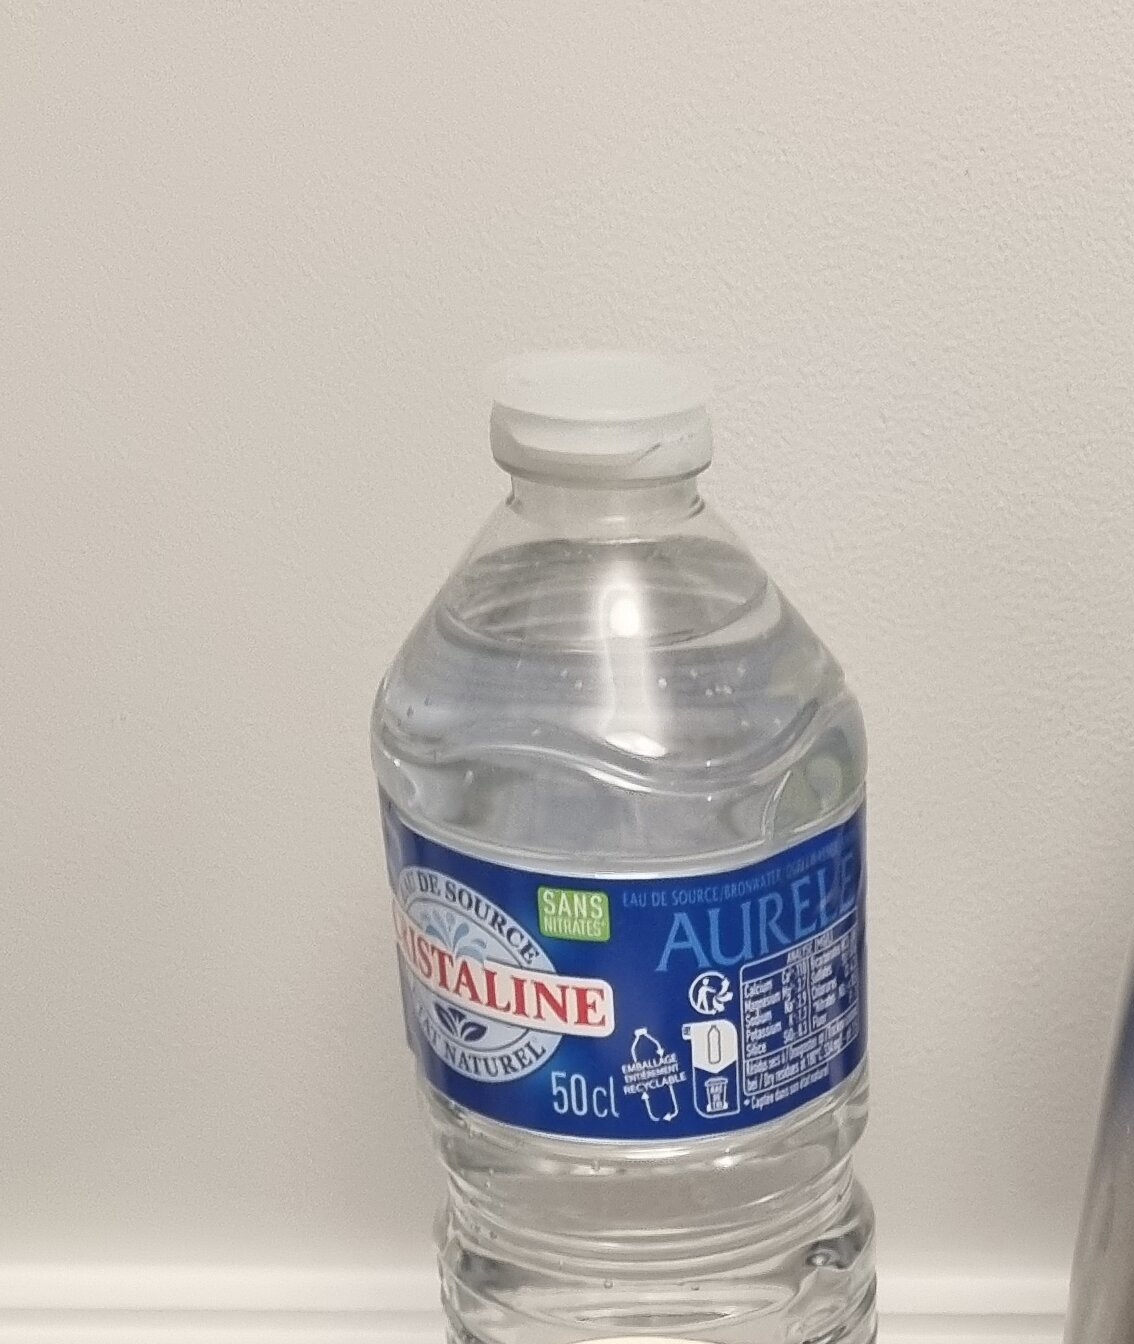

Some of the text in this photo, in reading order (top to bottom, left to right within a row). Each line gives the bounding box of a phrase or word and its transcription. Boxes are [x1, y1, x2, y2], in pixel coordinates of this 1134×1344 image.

[542, 890, 603, 919] SANS
[651, 891, 667, 907] DE
[418, 872, 540, 965] DE SOURCE
[443, 1040, 546, 1077] NATUREL
[622, 1053, 677, 1074] EMBALLAGE
[624, 1071, 686, 1094] RECYCLABLE
